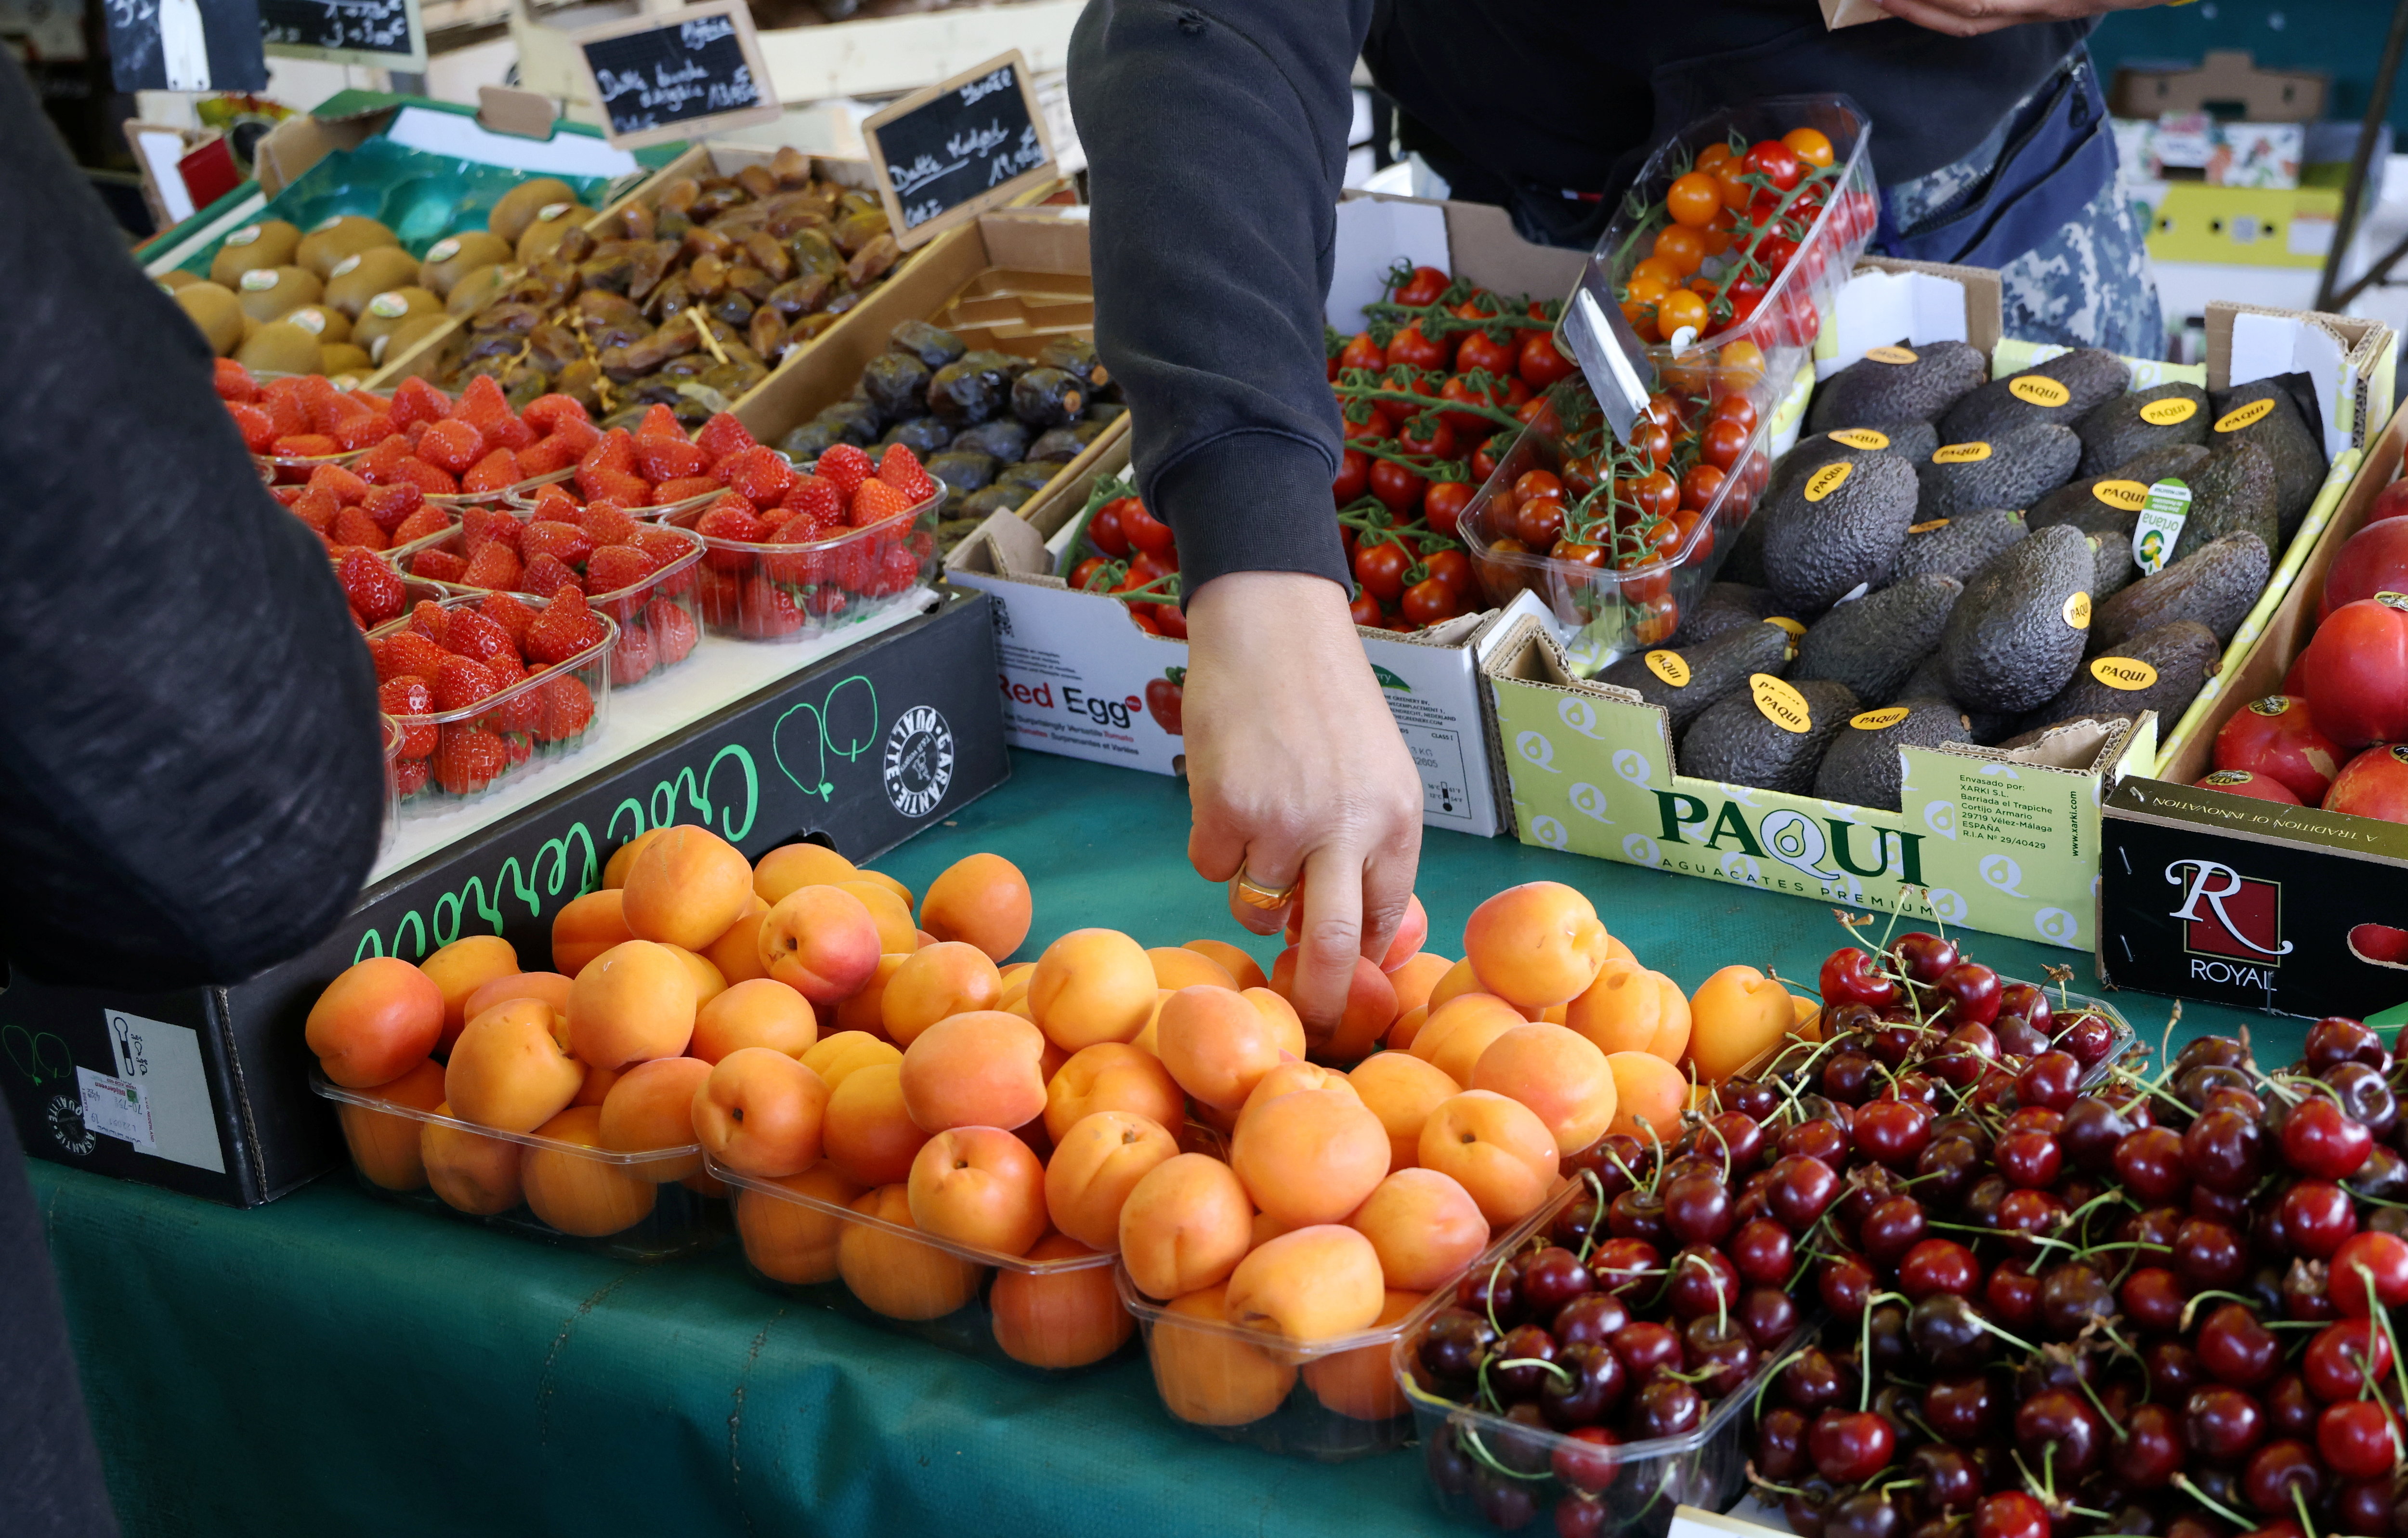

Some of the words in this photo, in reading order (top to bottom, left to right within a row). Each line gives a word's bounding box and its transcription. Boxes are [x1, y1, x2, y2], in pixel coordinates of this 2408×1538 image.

[2018, 383, 2059, 400] PAQUI
[2150, 405, 2186, 420] PAQUI
[2225, 405, 2264, 427] PAQUI
[1940, 448, 1981, 457] PAQUI
[1813, 466, 1844, 494] PAQUI
[2103, 488, 2145, 502] PAQUI
[2143, 513, 2179, 531] orlana
[2070, 603, 2088, 619] PAQUI
[1652, 654, 1682, 679] PAQUI
[2100, 665, 2146, 682] PAQUI
[1062, 687, 1130, 729] Egg
[1761, 696, 1802, 725] PAQUI
[1859, 713, 1900, 723] PAQUI
[886, 708, 936, 781] QUALITE
[1104, 730, 1133, 742] Tomato
[1960, 775, 2003, 787] Envasado
[1961, 784, 1989, 794] XARKI
[1993, 789, 2008, 798] S.L.
[1961, 793, 1999, 805] Barriada
[2013, 802, 2052, 814] Trapiche
[1962, 803, 1992, 814] Cortijo
[1996, 808, 2032, 819] Armario
[2153, 797, 2245, 819] INNOVATION
[1962, 812, 1988, 821] 29719
[1991, 816, 2052, 833] Vélez-Málaga
[1963, 821, 2001, 832] ESPAÑA
[2069, 791, 2078, 856] www.xarki.com
[2248, 814, 2268, 824] OF
[2273, 819, 2357, 840] TRADITION
[1650, 789, 1930, 887] PAQUI
[1963, 830, 1984, 839] R.I.A
[2001, 836, 2046, 849] 29/40429
[1662, 858, 1804, 891] AGUACATES
[1822, 887, 1933, 916] PREMIUM
[2165, 859, 2293, 955] R
[2192, 959, 2277, 991] ROYAL
[55, 1130, 95, 1154] ARANTIE
